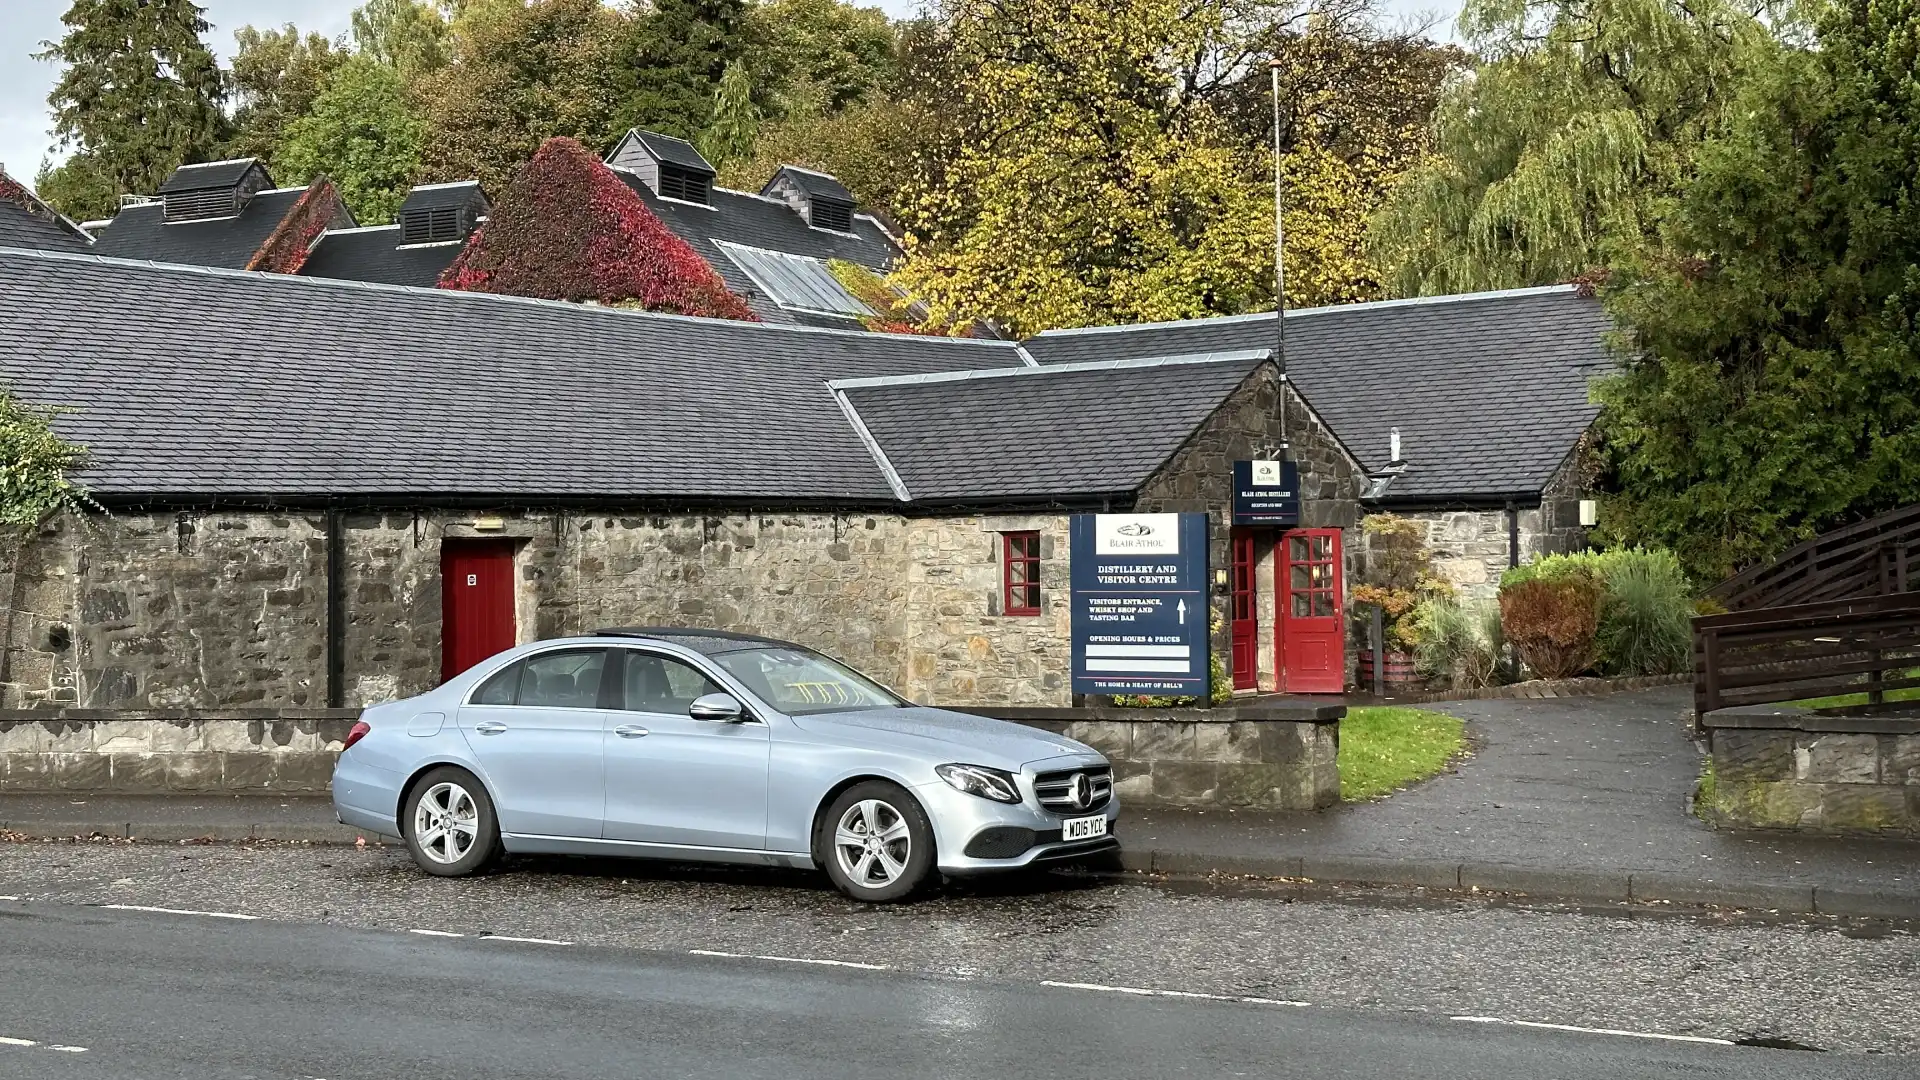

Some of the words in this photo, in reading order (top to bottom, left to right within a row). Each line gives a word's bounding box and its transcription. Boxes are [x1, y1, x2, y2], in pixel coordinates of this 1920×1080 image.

[1110, 539, 1133, 548] BLAIR
[1136, 539, 1164, 548] ATHOL
[1097, 565, 1154, 574] DISTILLERY
[1156, 565, 1177, 574] AND
[1097, 575, 1136, 584] VISITOR
[1138, 575, 1178, 584] CENTRE
[1089, 598, 1121, 606] VISITORS
[1123, 598, 1163, 606] ENTRANCE,
[1122, 635, 1146, 643] HOURS
[1069, 820, 1088, 837] WD16
[1090, 818, 1103, 834] YCC
